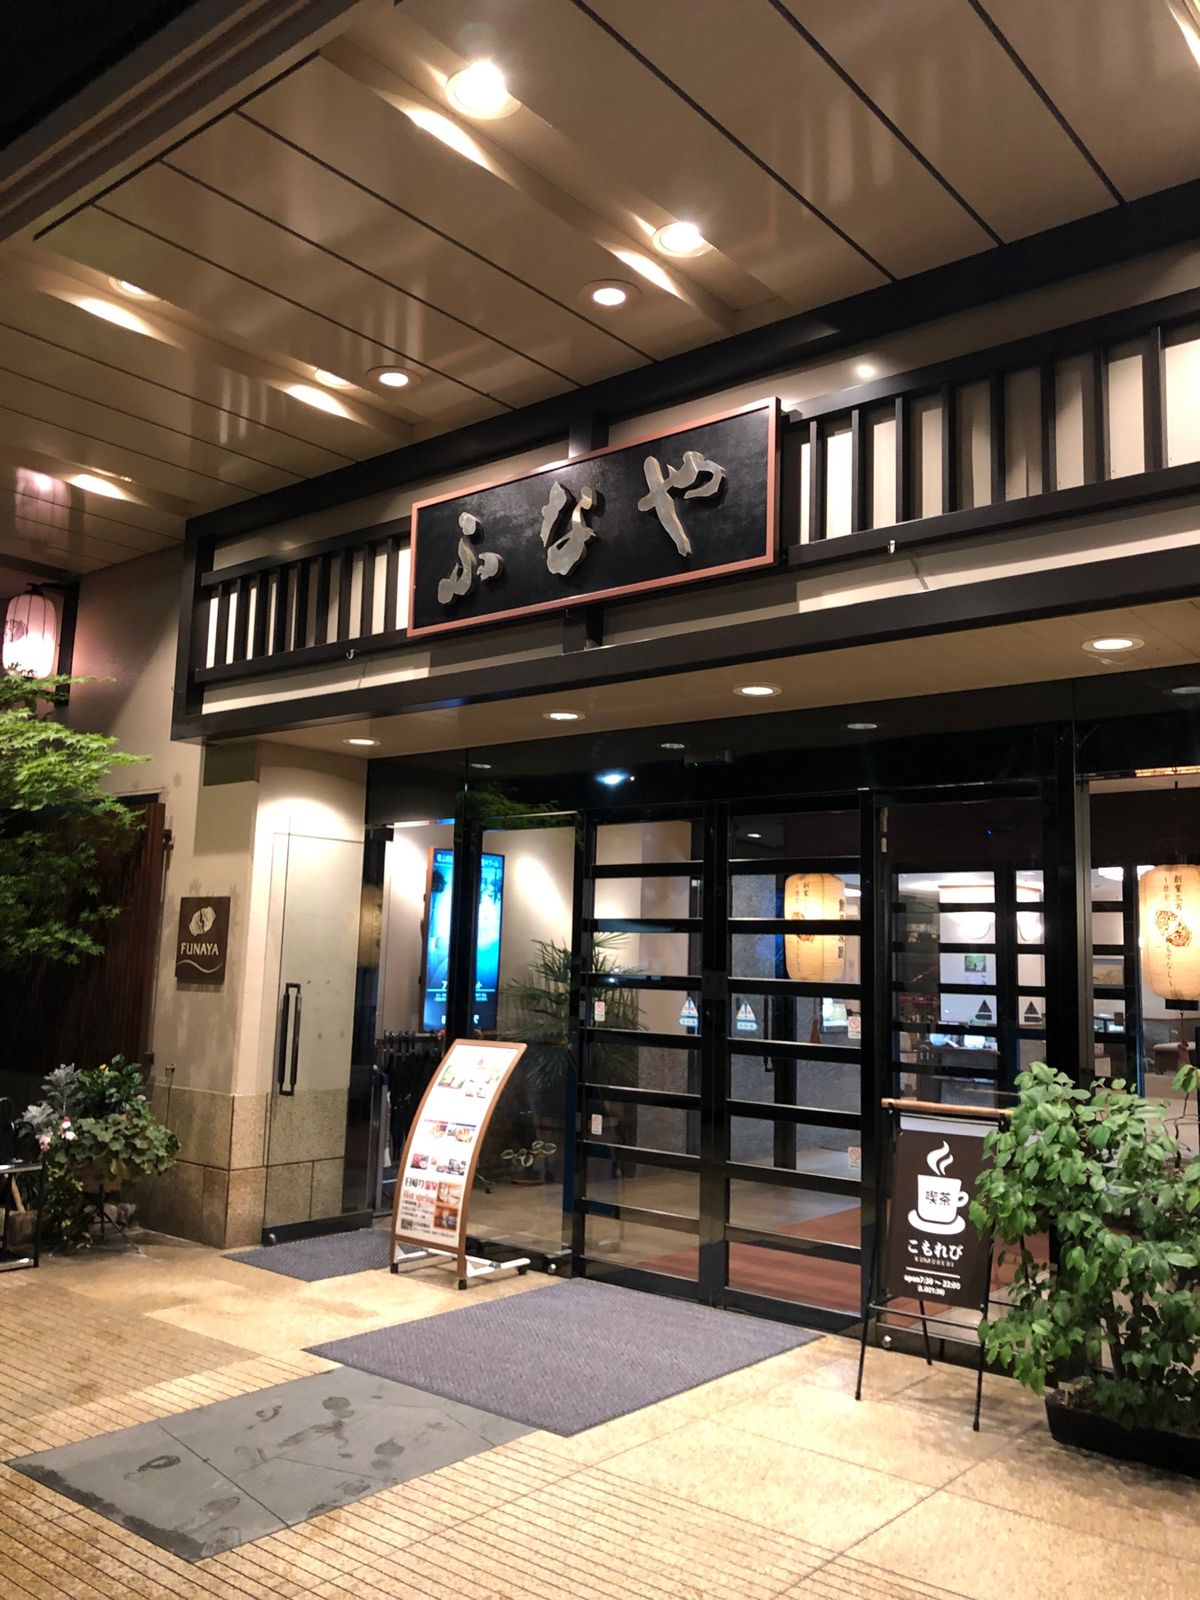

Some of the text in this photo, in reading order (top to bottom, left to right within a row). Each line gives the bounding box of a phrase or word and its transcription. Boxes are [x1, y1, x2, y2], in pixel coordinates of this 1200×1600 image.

[437, 450, 726, 605] ふなや
[180, 942, 219, 955] FUNAYA
[925, 1190, 952, 1206] 喫茶
[907, 1238, 964, 1261] こもれび
